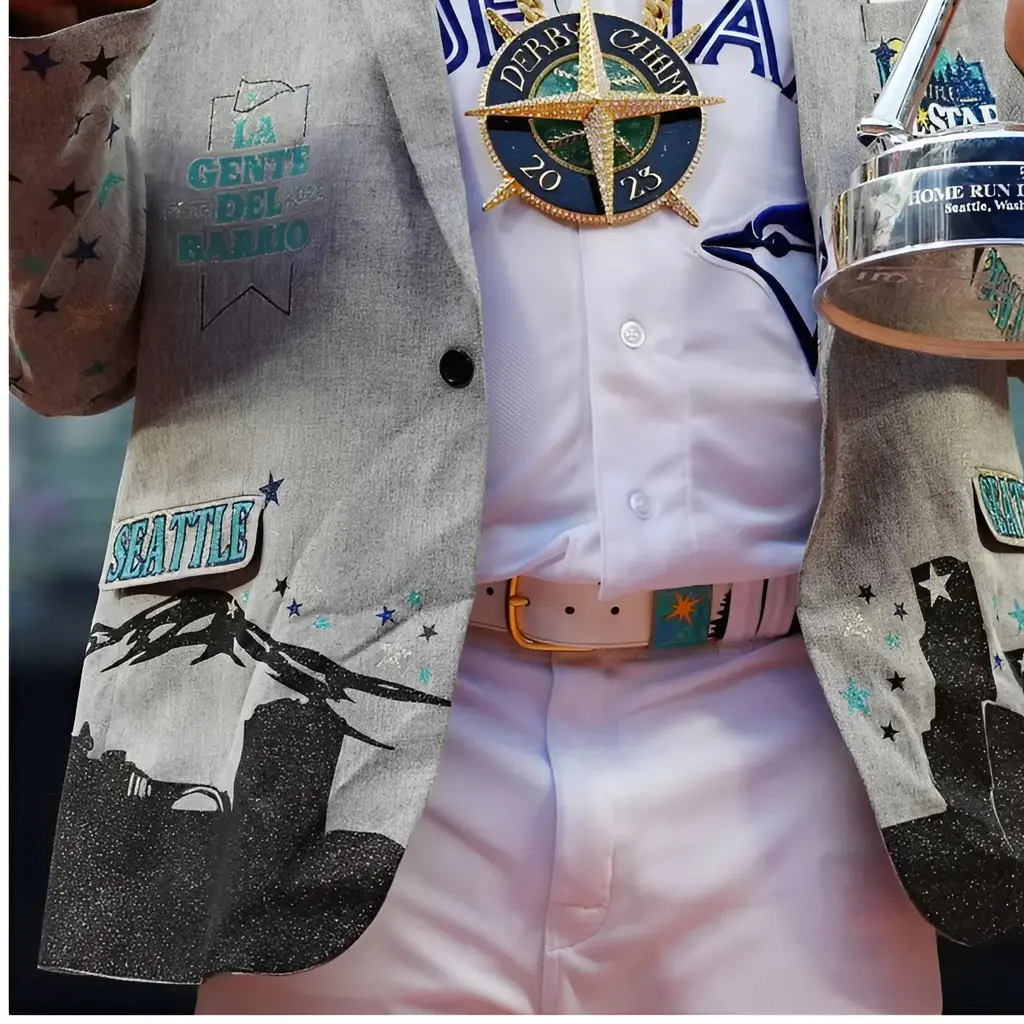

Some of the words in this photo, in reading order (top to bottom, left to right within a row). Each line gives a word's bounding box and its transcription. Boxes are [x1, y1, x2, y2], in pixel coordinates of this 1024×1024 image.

[608, 27, 692, 97] CHAM
[231, 114, 278, 150] LA
[186, 144, 311, 191] GENTE
[519, 153, 563, 192] 20
[619, 164, 663, 201] 23
[214, 186, 284, 226] DEL
[907, 184, 965, 207] HOME
[969, 183, 1011, 199] RUN
[104, 499, 256, 584] SEATTLE
